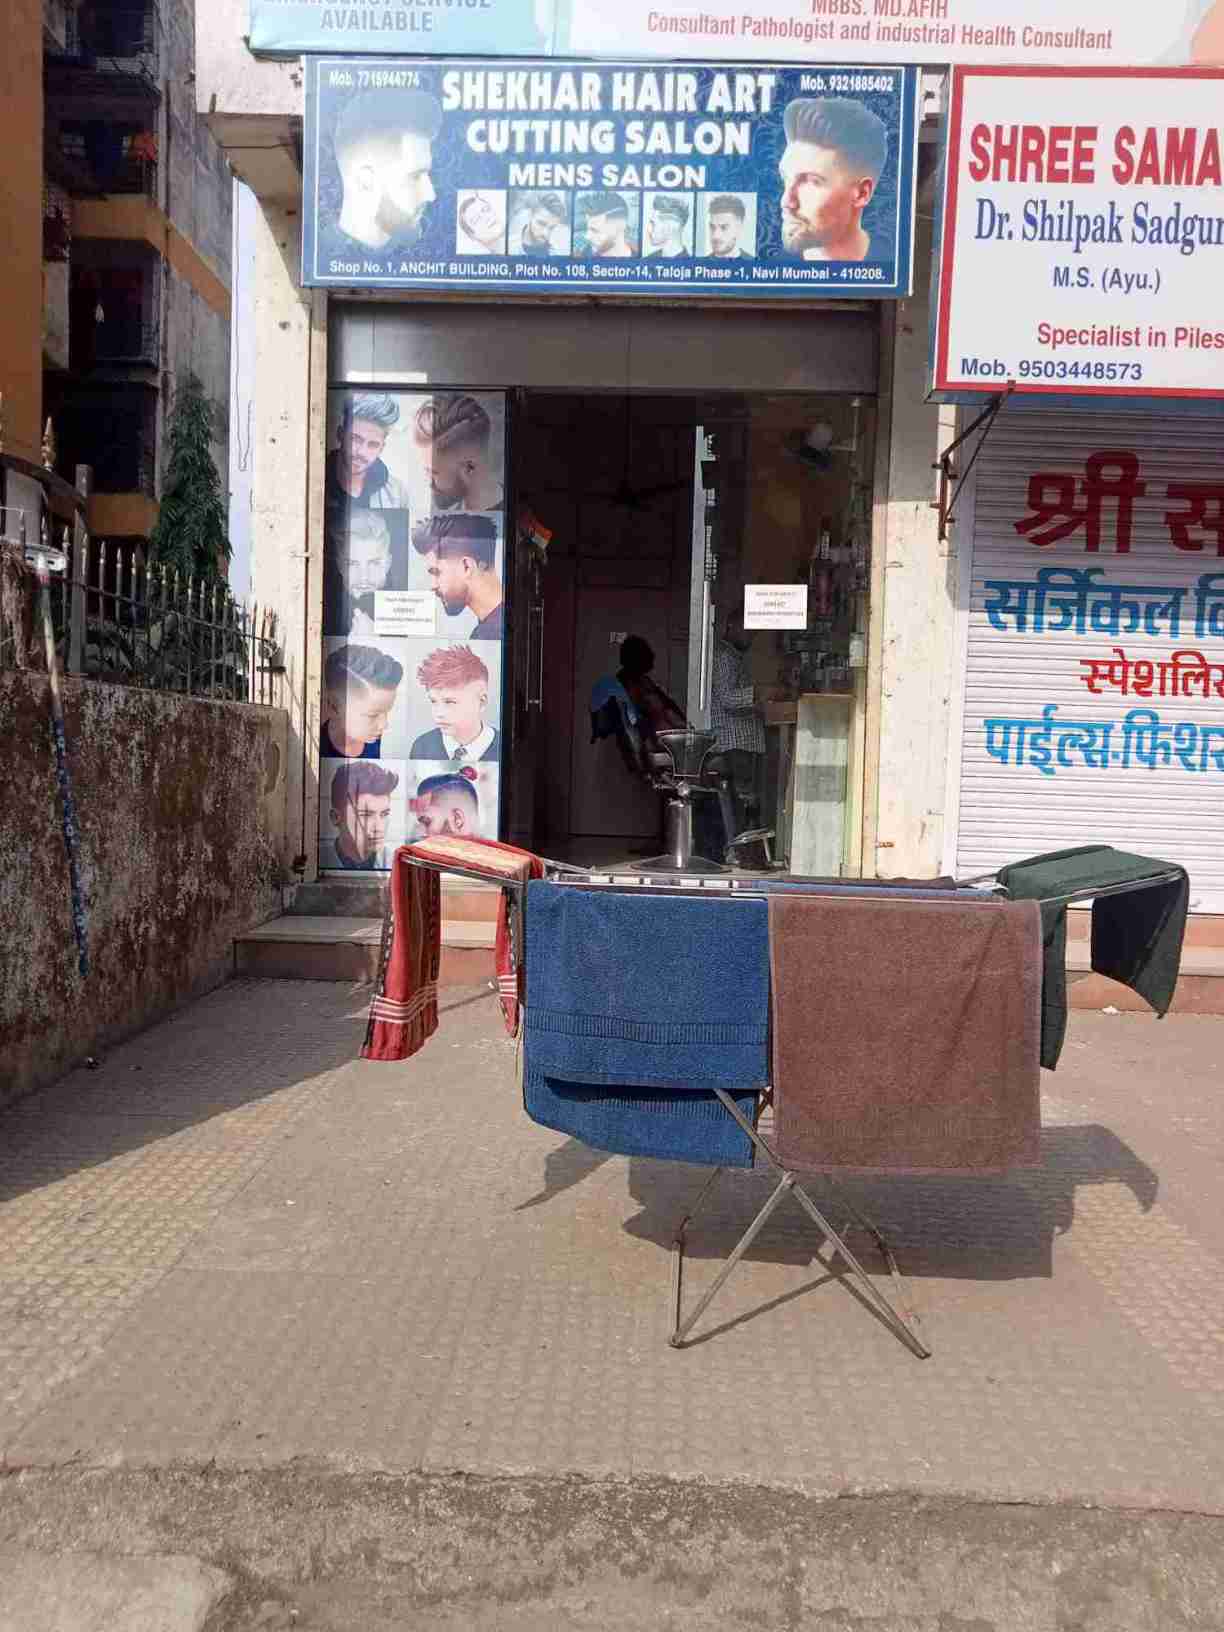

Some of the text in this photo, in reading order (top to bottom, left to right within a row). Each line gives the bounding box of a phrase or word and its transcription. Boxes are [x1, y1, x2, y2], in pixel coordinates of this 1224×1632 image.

[320, 9, 432, 32] AVAILABLE
[811, 0, 867, 16] MBBS.
[648, 12, 1112, 49] Consultant Pathologist and industrial Health Consultant
[442, 71, 775, 113] SHEKHAR HAIR ART
[800, 75, 826, 91] Mob.
[466, 119, 750, 155] CUTTING SALON
[968, 123, 1222, 186] SHREE SAMA
[509, 163, 706, 188] MENS SALON
[974, 198, 1013, 240] Dr.
[1022, 199, 1124, 253] Shilpak
[329, 260, 359, 275] Shop
[363, 261, 383, 273] No.
[400, 262, 446, 275] ANCHIT
[450, 262, 512, 277] BUILDING,
[515, 264, 538, 276] Plot
[542, 264, 560, 276] No.
[565, 264, 589, 278] 108,
[592, 265, 651, 279] Sector-14,
[656, 265, 691, 280] Taloja
[695, 266, 731, 278] Phase
[753, 267, 778, 279] Navi
[783, 267, 829, 279] Mumbai
[1053, 266, 1162, 294] M.S. (Ayu.)
[1037, 322, 1224, 350] Specialist in Piles
[961, 358, 1142, 380] Mob. 9503448573
[1012, 451, 1147, 553] श्री
[984, 568, 1189, 638] सर्जिकल
